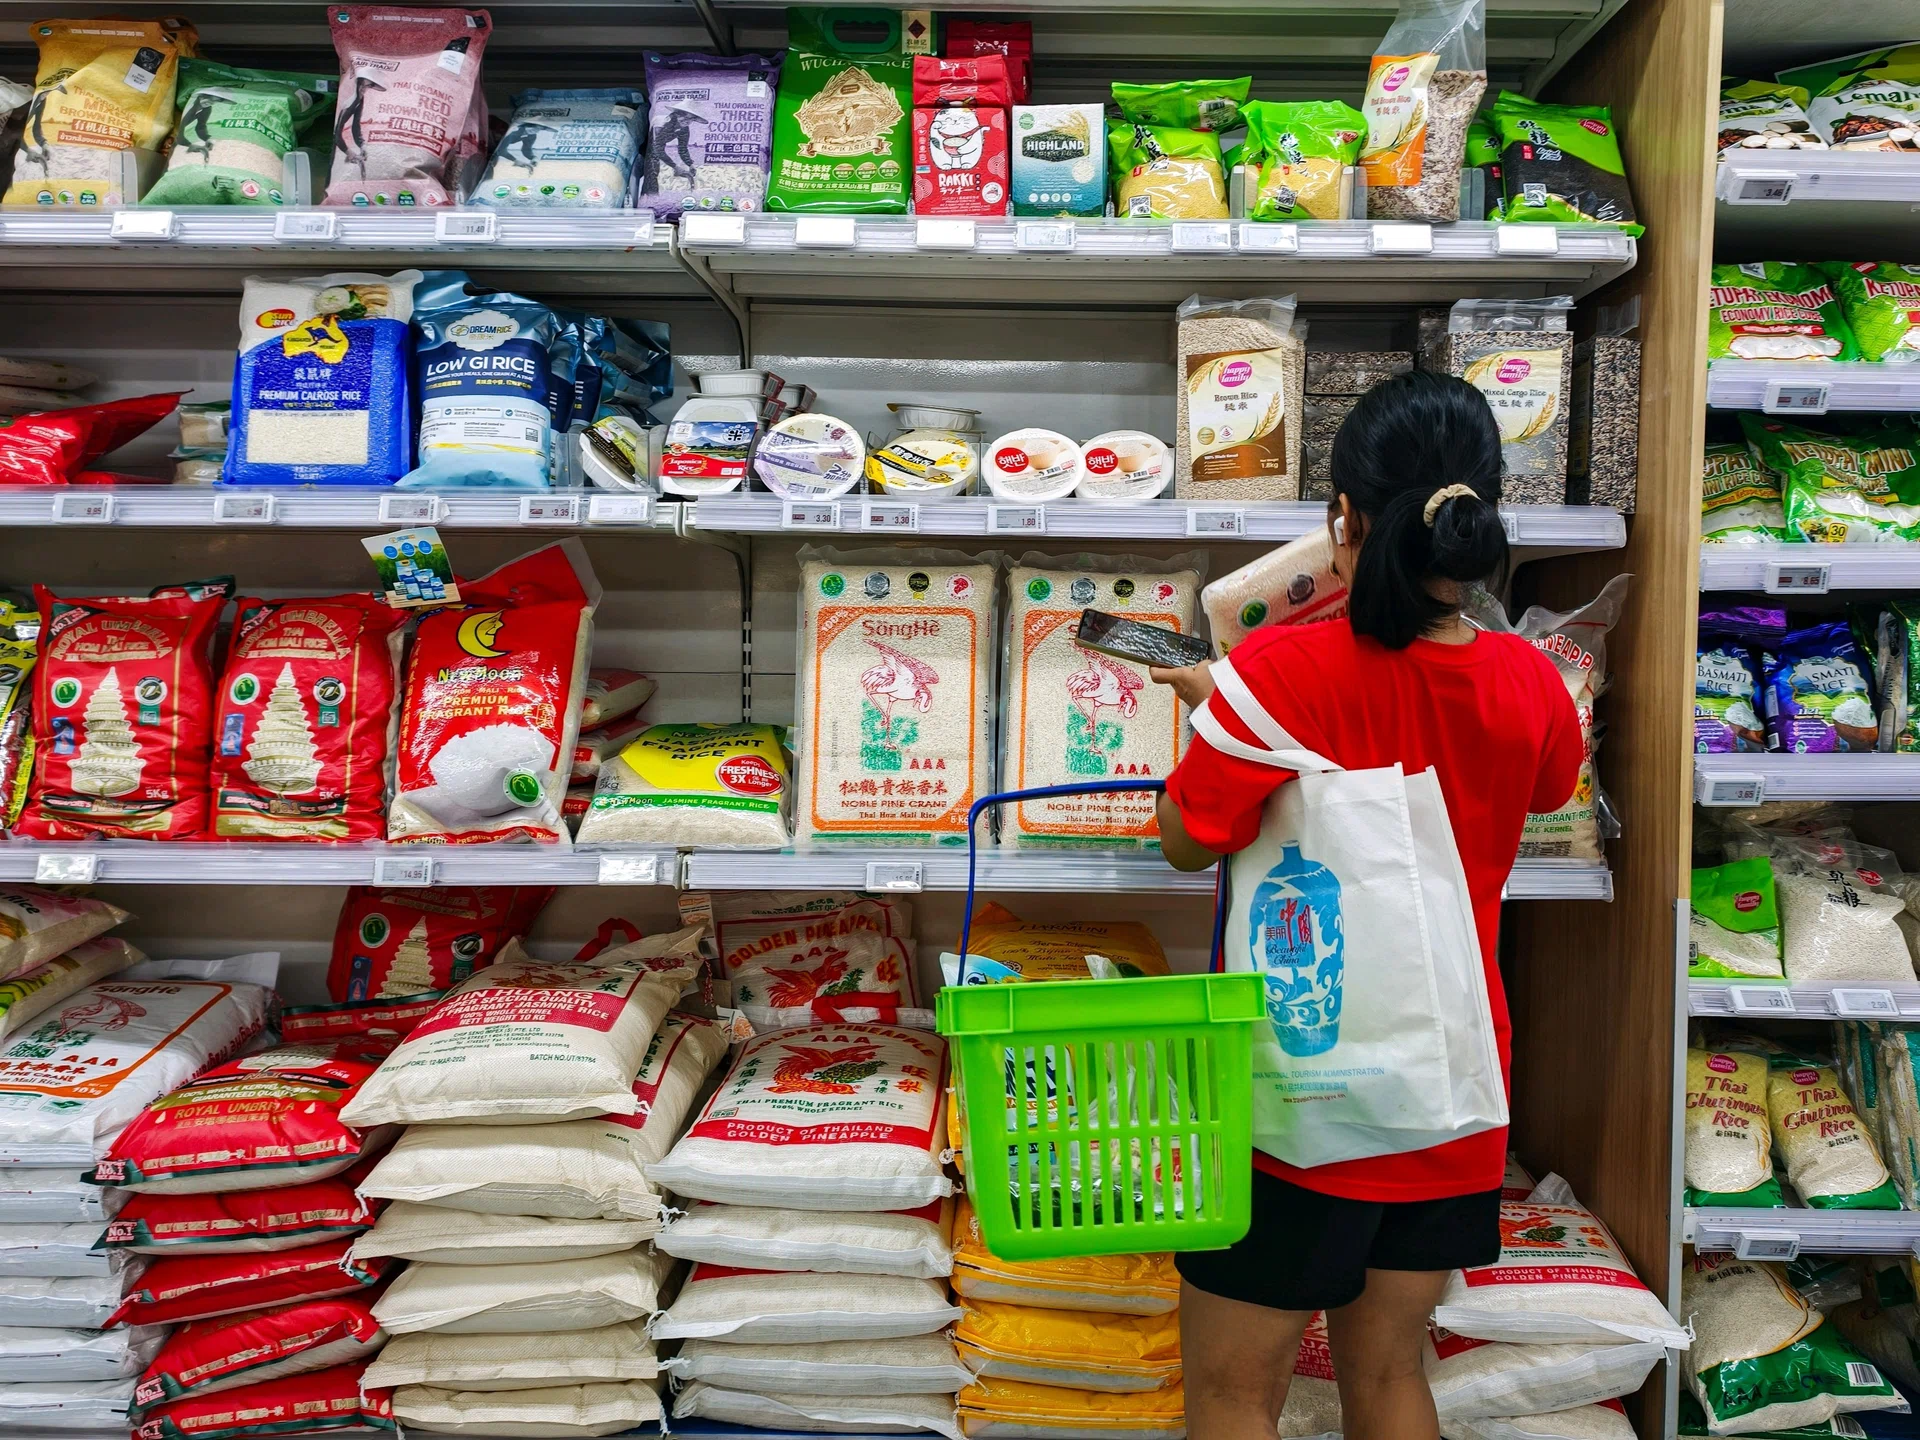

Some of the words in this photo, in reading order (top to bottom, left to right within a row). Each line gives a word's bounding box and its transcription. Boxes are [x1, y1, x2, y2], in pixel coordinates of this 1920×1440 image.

[418, 93, 452, 117] RED
[720, 111, 764, 122] THREE
[708, 122, 762, 133] COLOUR
[704, 133, 739, 141] BROWN
[740, 134, 762, 142] RICE
[1026, 140, 1086, 151] HIGHLAND
[938, 173, 974, 187] RAKKI
[939, 187, 974, 195] ラッキー
[1766, 188, 1783, 197] 3.46
[305, 224, 325, 233] 11.40
[465, 225, 485, 234] 11.40
[1766, 285, 1834, 308] EKONOMI
[1722, 309, 1770, 322] ECONOMY
[1774, 309, 1797, 321] RICE
[427, 356, 467, 377] LOW
[469, 356, 489, 369] GI
[492, 356, 536, 375] RICE
[1223, 366, 1250, 376] happy
[1501, 362, 1530, 372] happy
[294, 367, 331, 380] 袋鼠牌
[1221, 374, 1250, 383] family
[1497, 370, 1529, 379] family
[259, 390, 298, 400] PREMIUM
[301, 390, 339, 401] CALROSE
[341, 391, 361, 401] RICE
[1214, 393, 1239, 402] Brown
[1240, 391, 1259, 400] Rice
[1483, 388, 1505, 396] Mixed
[1507, 388, 1528, 397] Cargo
[1529, 389, 1547, 397] Rice
[1224, 402, 1248, 412] 糙米
[669, 458, 702, 466] Japonica
[999, 454, 1025, 469] 햇반
[1087, 454, 1114, 469] 햇반
[1781, 442, 1858, 473] KETUPAT
[1863, 447, 1915, 476] MINI
[1261, 461, 1279, 470] 1.8kg
[1724, 472, 1750, 490] RICE
[552, 508, 569, 517] 3.35
[815, 514, 831, 523] 3.30
[894, 516, 910, 525] 3.30
[1021, 518, 1036, 526] 1.80
[1219, 521, 1235, 529] 4.25
[1830, 525, 1845, 537] 30
[280, 609, 351, 660] UMBRELLA
[50, 622, 98, 660] ROYAL
[304, 638, 328, 649] RICE
[1698, 665, 1747, 683] BASMATI
[1706, 679, 1733, 693] RICE
[443, 695, 509, 706] PREMIUM
[418, 705, 491, 721] FRAGRANT
[641, 738, 765, 753] FRAGRANT
[670, 749, 726, 761] RICE
[720, 765, 781, 782] FRESHNESS
[729, 774, 746, 785] 3X
[748, 779, 773, 788] Longer
[839, 778, 948, 796] 松鶴貴族香米
[145, 788, 169, 799] 5Kg
[1738, 790, 1754, 798] 3.65
[564, 802, 584, 810] RICE
[701, 798, 748, 808] FRAGRANT
[841, 800, 878, 808] NOBLE
[880, 800, 906, 808] PINE
[908, 800, 948, 808] CRANE
[1047, 803, 1083, 812] NOBLE
[1086, 804, 1111, 813] PINE
[1113, 805, 1153, 813] CRANE
[859, 811, 877, 819] Thai
[899, 811, 918, 819] Mali
[920, 811, 938, 819] Rice
[1526, 811, 1577, 823] FRAGRANT
[1543, 824, 1574, 833] KERNEL
[403, 870, 423, 879] 14.95
[8, 895, 41, 916] Rice
[805, 902, 825, 912] BEST
[1265, 926, 1286, 941] 美丽
[727, 928, 798, 969] GOLDEN
[1273, 954, 1301, 966] China
[492, 988, 595, 1000] HUANG
[438, 998, 477, 1014] SUPER
[481, 995, 536, 1005] SPECIAL
[540, 995, 597, 1008] QUALITY
[1768, 998, 1784, 1007] 1.21
[446, 1002, 511, 1018] FRAGRANT
[514, 1000, 574, 1010] JASMINE
[576, 1008, 610, 1021] RICE
[459, 1012, 484, 1020] 100%
[485, 1009, 516, 1017] WHOLE
[483, 1015, 517, 1023] WEIGHT
[745, 1026, 824, 1056] GOLDEN
[832, 1025, 939, 1057] PINEAPPLE
[811, 1034, 873, 1044] AAA
[529, 1053, 553, 1062] BATCH
[1710, 1056, 1737, 1068] happy
[1291, 1070, 1321, 1079] TOURISM
[1323, 1067, 1385, 1078] ADMINISTRATION
[1709, 1063, 1737, 1073] family
[33, 1072, 77, 1083] CRANE
[1792, 1071, 1818, 1081] happy
[39, 1078, 62, 1087] Rice
[1704, 1076, 1749, 1095] Thai
[206, 1084, 241, 1097] WHOLE
[191, 1090, 258, 1103] GUARANTEED
[1796, 1087, 1839, 1106] Thai
[736, 1098, 762, 1106] THAI
[764, 1097, 814, 1108] PREMIUM
[816, 1100, 876, 1109] FRAGRANT
[877, 1101, 905, 1110] RICE
[1685, 1092, 1767, 1117] Glutinous
[174, 1104, 221, 1119] ROYAL
[797, 1106, 827, 1114] WHOLE
[828, 1105, 863, 1113] KERNEL
[1711, 1110, 1751, 1129] Rice
[726, 1121, 795, 1136] PRODUCT
[800, 1127, 819, 1136] OF
[822, 1124, 894, 1134] THAILAND
[1819, 1118, 1855, 1138] Rice
[727, 1130, 790, 1142] GOLDEN
[802, 1132, 889, 1142] PINEAPPLE
[97, 1163, 125, 1176] No.1
[107, 1224, 135, 1237] No.1
[1491, 1267, 1542, 1277] PRODUCT
[1564, 1267, 1619, 1278] THAILAND
[1706, 1264, 1757, 1284] 泰国糯米
[1495, 1274, 1544, 1282] GOLDEN
[1551, 1274, 1619, 1283] PINEAPPLE
[135, 1383, 164, 1402] No.1
